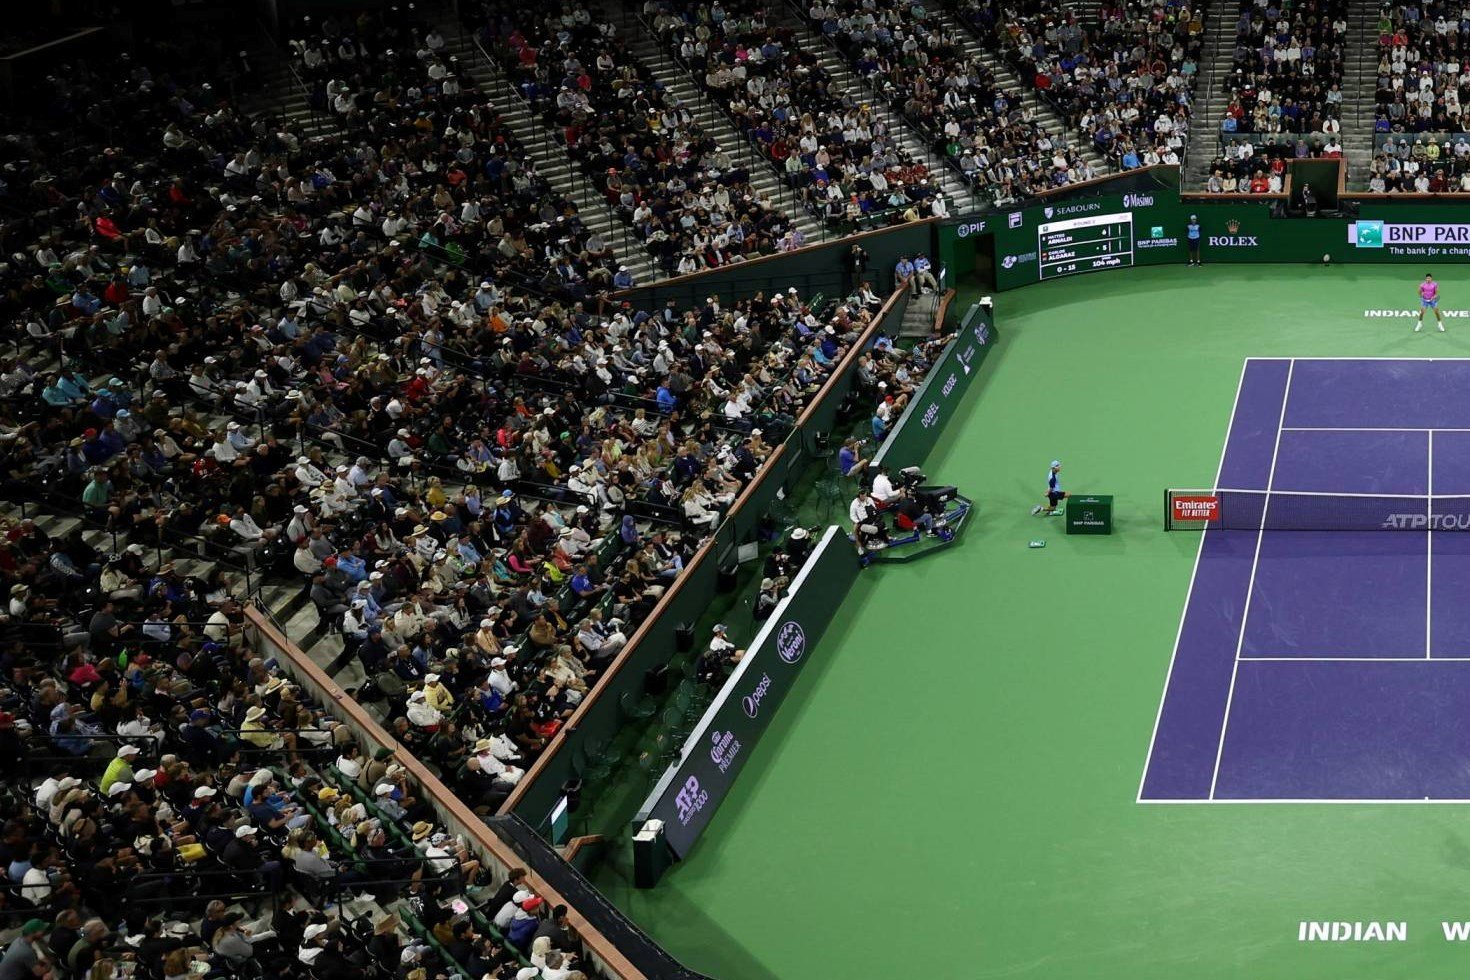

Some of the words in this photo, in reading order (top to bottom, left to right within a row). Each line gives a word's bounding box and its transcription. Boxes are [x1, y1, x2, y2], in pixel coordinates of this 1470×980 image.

[1056, 203, 1101, 215] SEABOURN
[969, 221, 986, 234] PIF
[1389, 227, 1426, 241] BNP
[1047, 236, 1073, 245] ARNALDI
[1208, 236, 1258, 246] ROLEX
[1390, 247, 1404, 255] The
[1406, 247, 1426, 255] bank
[1428, 247, 1440, 256] for
[1106, 257, 1121, 266] mph
[1364, 310, 1422, 318] INDIAN
[921, 402, 939, 428] DOBEL
[1175, 501, 1217, 510] Emirates
[1382, 513, 1427, 529] ATP
[752, 671, 772, 706] pepsi
[710, 731, 734, 764] Corona
[718, 740, 742, 774] PREMIER
[675, 775, 699, 821] ATP
[1298, 921, 1407, 941] INDIAN
